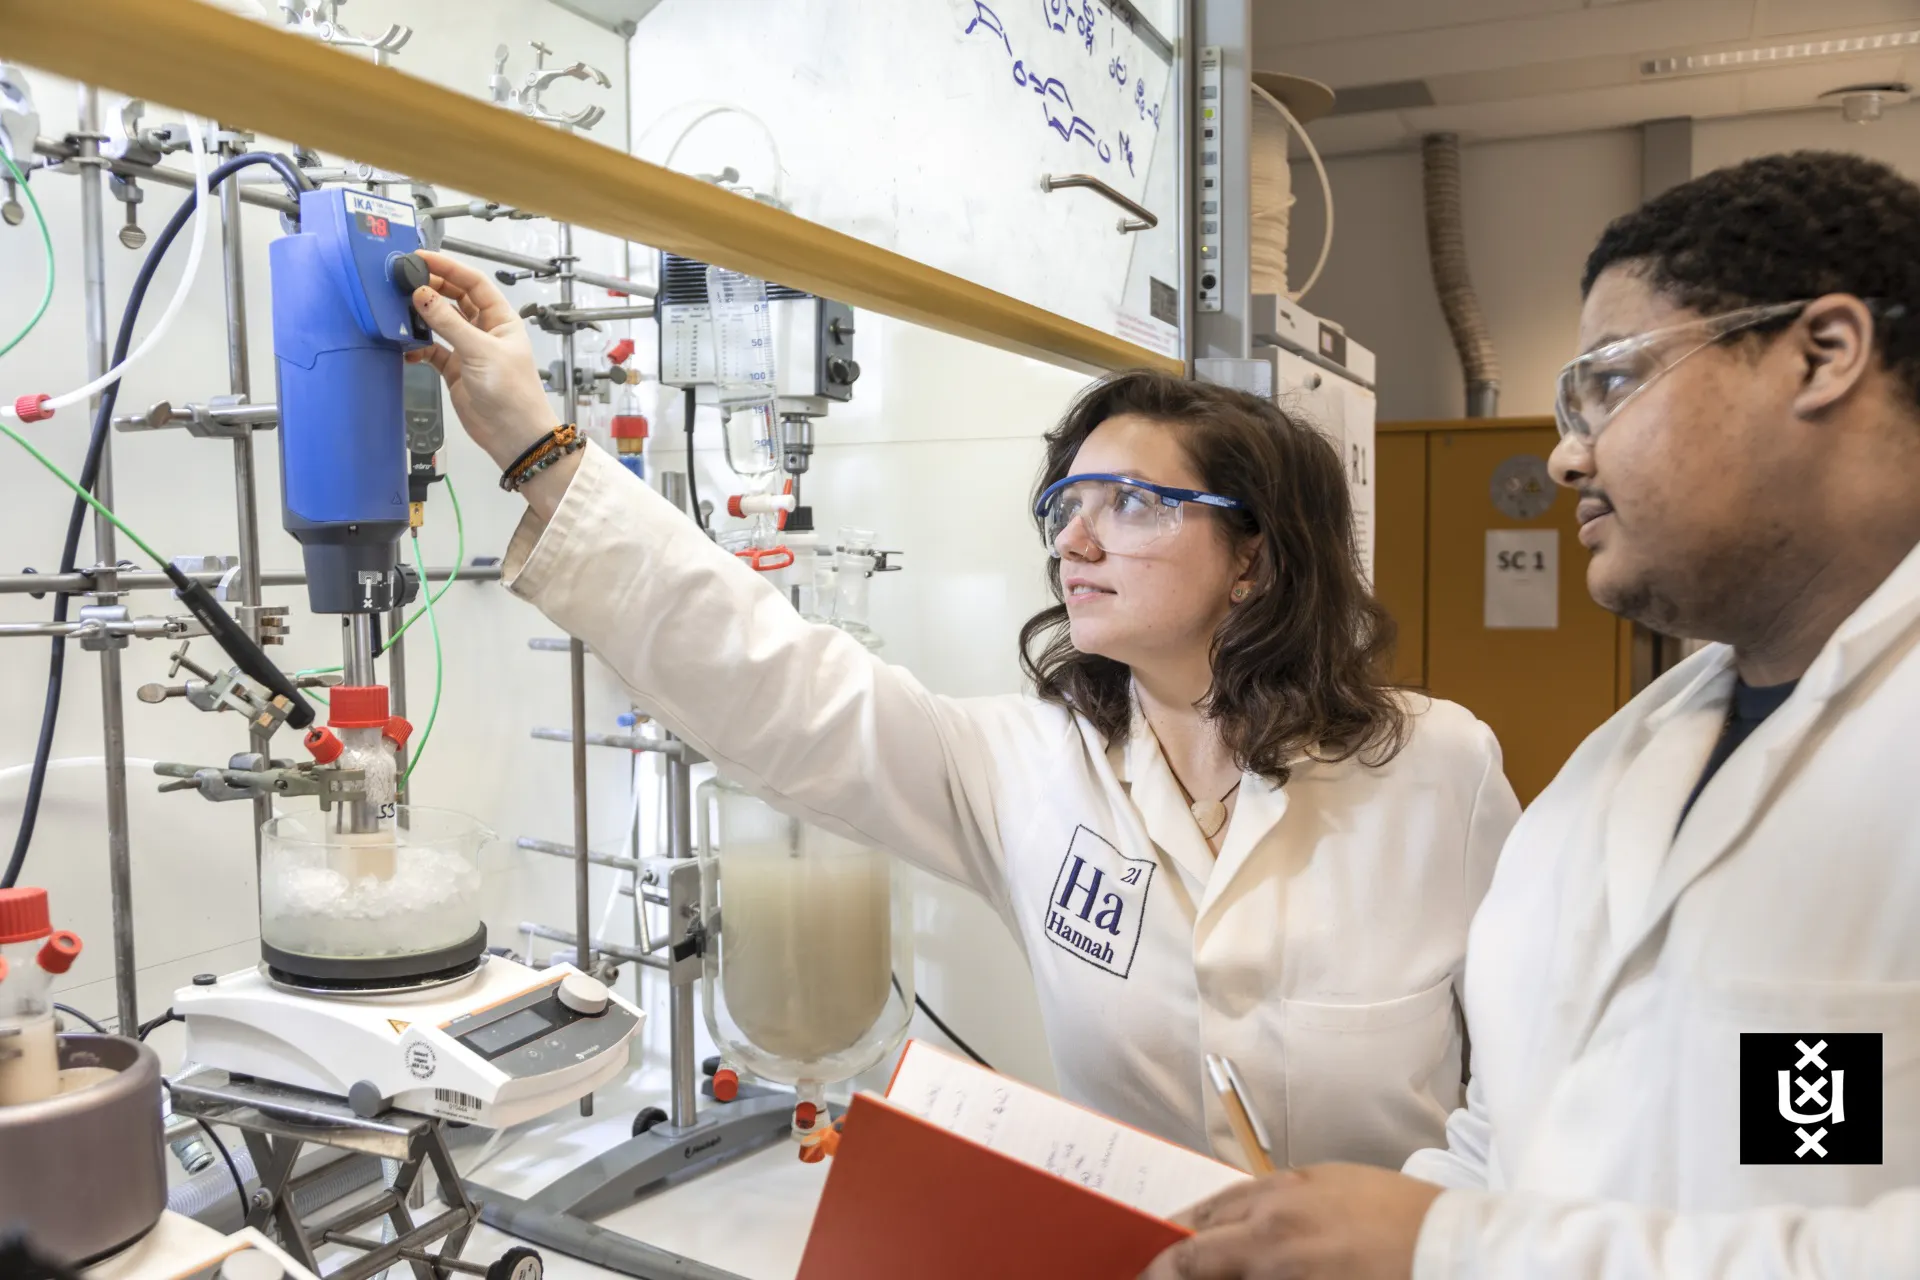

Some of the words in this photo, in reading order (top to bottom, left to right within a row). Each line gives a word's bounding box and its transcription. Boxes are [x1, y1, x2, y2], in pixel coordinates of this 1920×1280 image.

[353, 196, 373, 212] IKA
[751, 338, 763, 347] 50
[750, 372, 766, 381] 100
[1497, 550, 1526, 571] SC
[1533, 550, 1546, 571] 1
[1120, 867, 1142, 886] 21
[1055, 854, 1124, 936] Ha
[1047, 910, 1114, 964] Hannah
